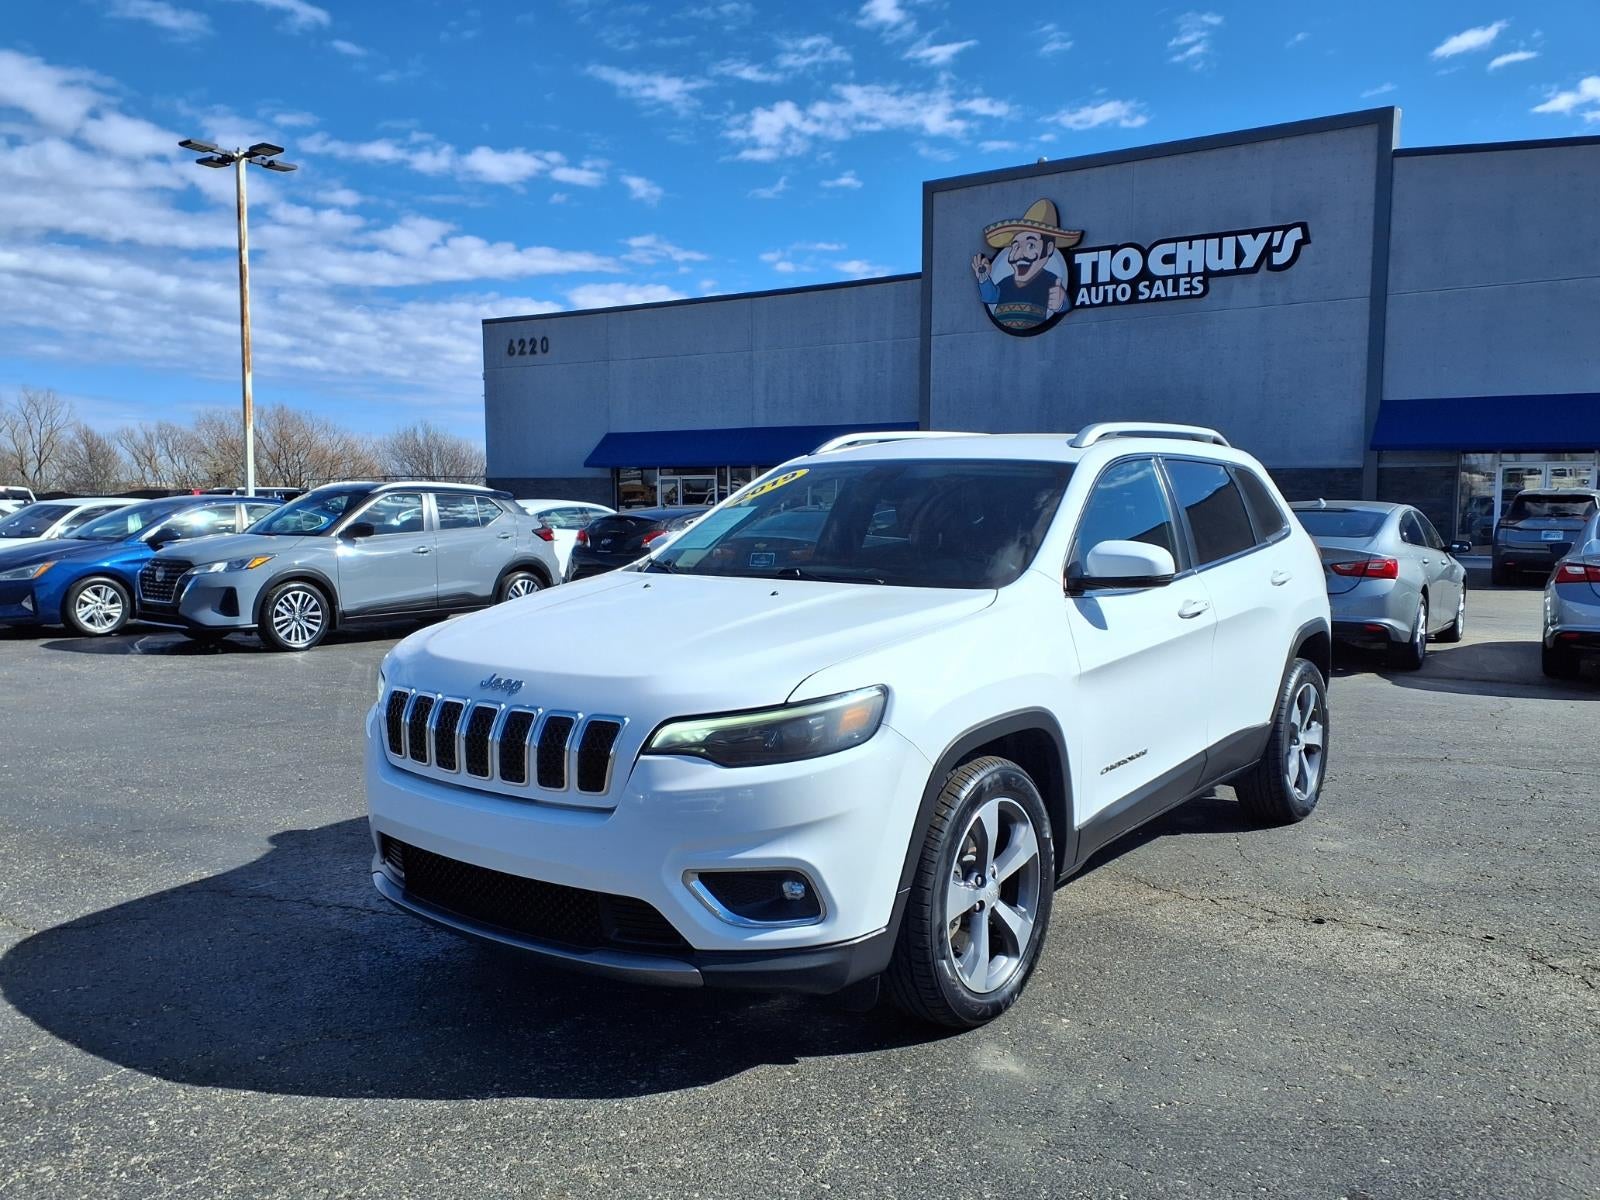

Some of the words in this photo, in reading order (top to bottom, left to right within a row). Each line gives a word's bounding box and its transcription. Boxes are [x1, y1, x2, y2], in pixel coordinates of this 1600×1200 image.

[1075, 247, 1143, 285] TIO
[1148, 226, 1304, 277] CHUY'S
[1075, 282, 1132, 306] AUTO
[1138, 275, 1204, 301] SALES
[507, 336, 549, 356] 6220
[733, 472, 798, 503] 2019
[480, 673, 525, 696] Jeep
